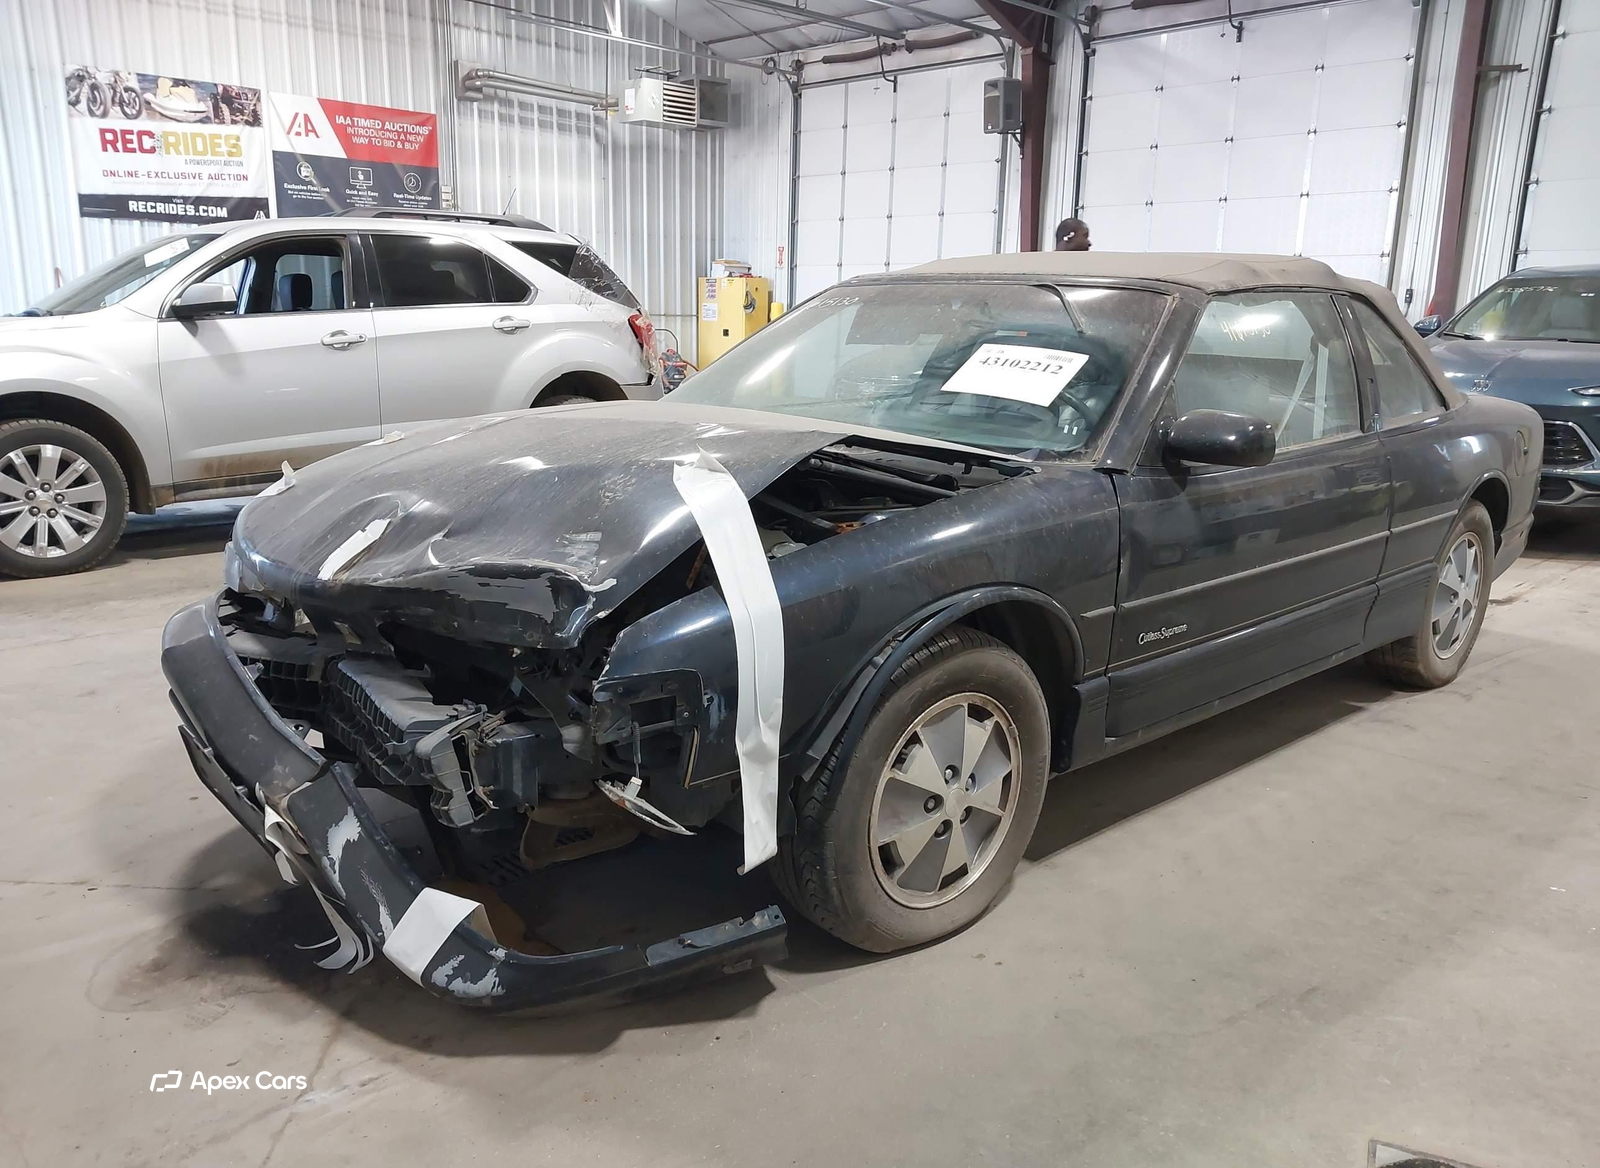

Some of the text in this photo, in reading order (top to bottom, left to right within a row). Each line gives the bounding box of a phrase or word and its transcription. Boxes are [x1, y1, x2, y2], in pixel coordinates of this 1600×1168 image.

[335, 115, 351, 126] IAA
[352, 117, 382, 129] TIMED
[347, 126, 398, 140] INTRODUCING
[406, 134, 424, 143] NEW
[352, 136, 420, 151] WAY TO BID & BUY
[189, 159, 222, 167] POWERSPORT
[102, 169, 249, 182] ONLINE-EXCLUSIVE AUCTION
[284, 182, 306, 190] Exclusive
[128, 200, 228, 218] RECRIDES.COM
[979, 356, 1063, 375] 43102212
